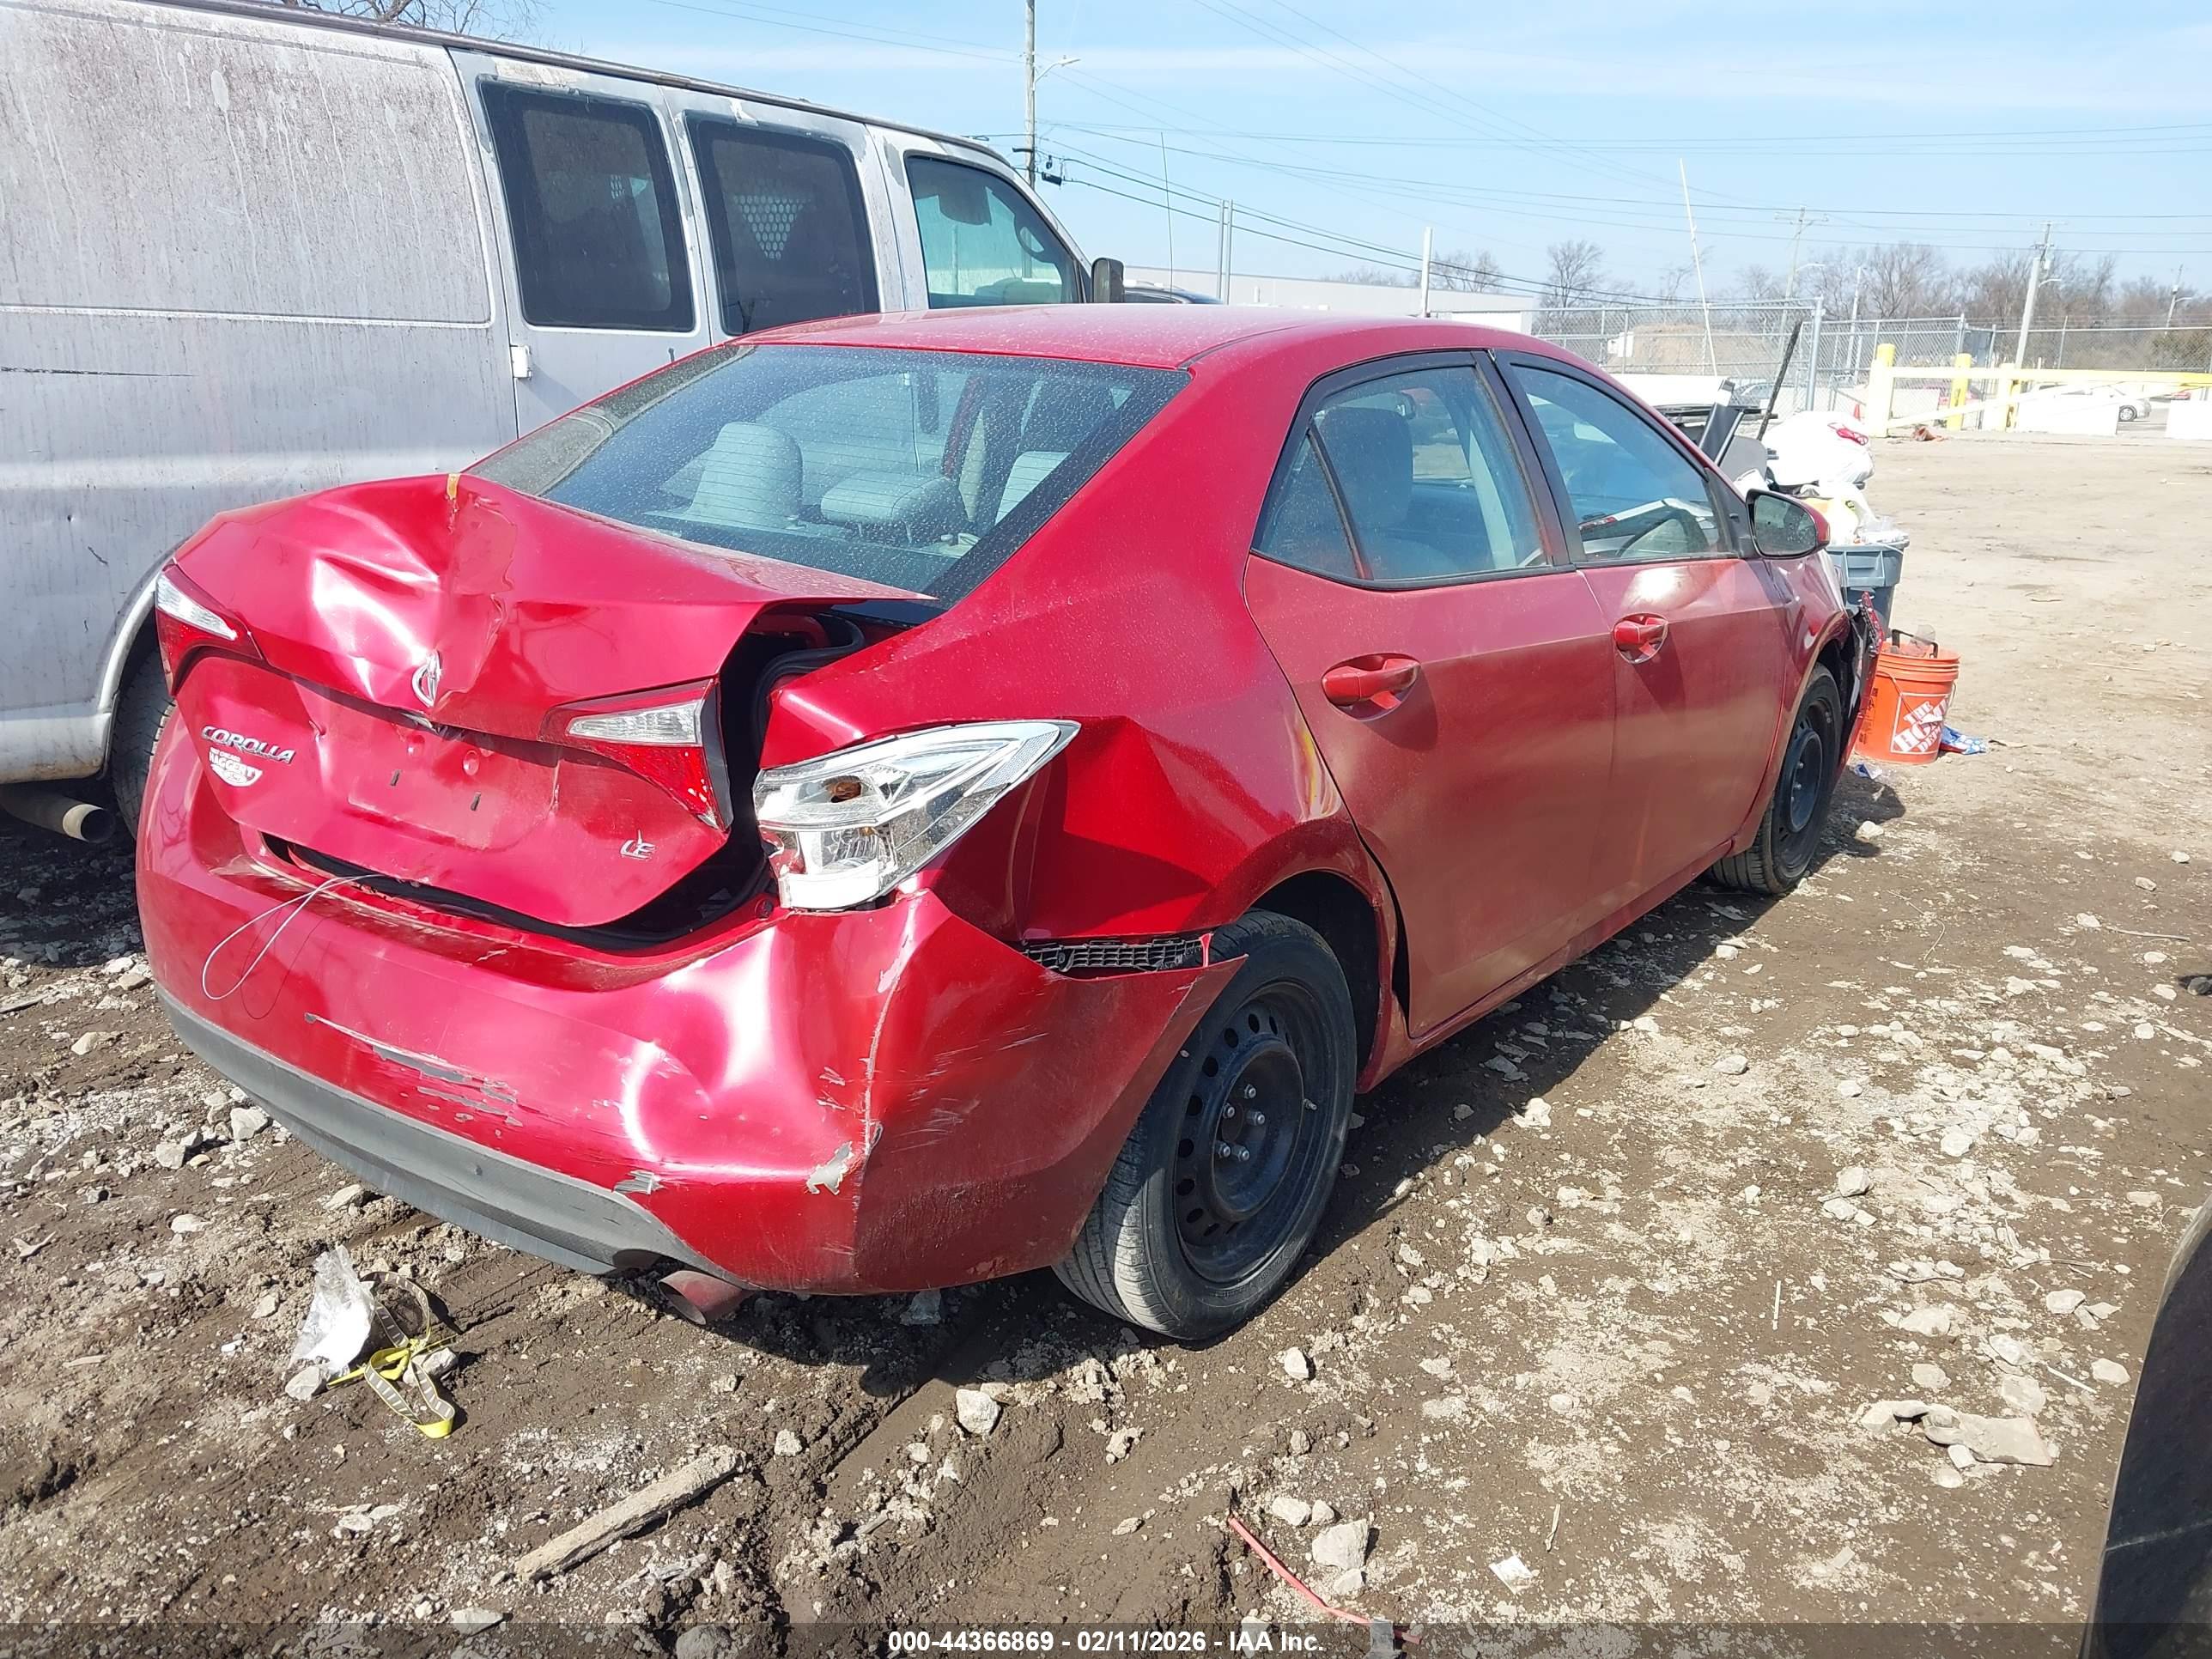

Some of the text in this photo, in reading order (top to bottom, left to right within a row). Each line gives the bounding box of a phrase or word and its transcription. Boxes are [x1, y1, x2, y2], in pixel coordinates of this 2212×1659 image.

[1903, 701, 1934, 726] THE
[201, 726, 296, 764] COROLLA
[620, 838, 657, 861] LE
